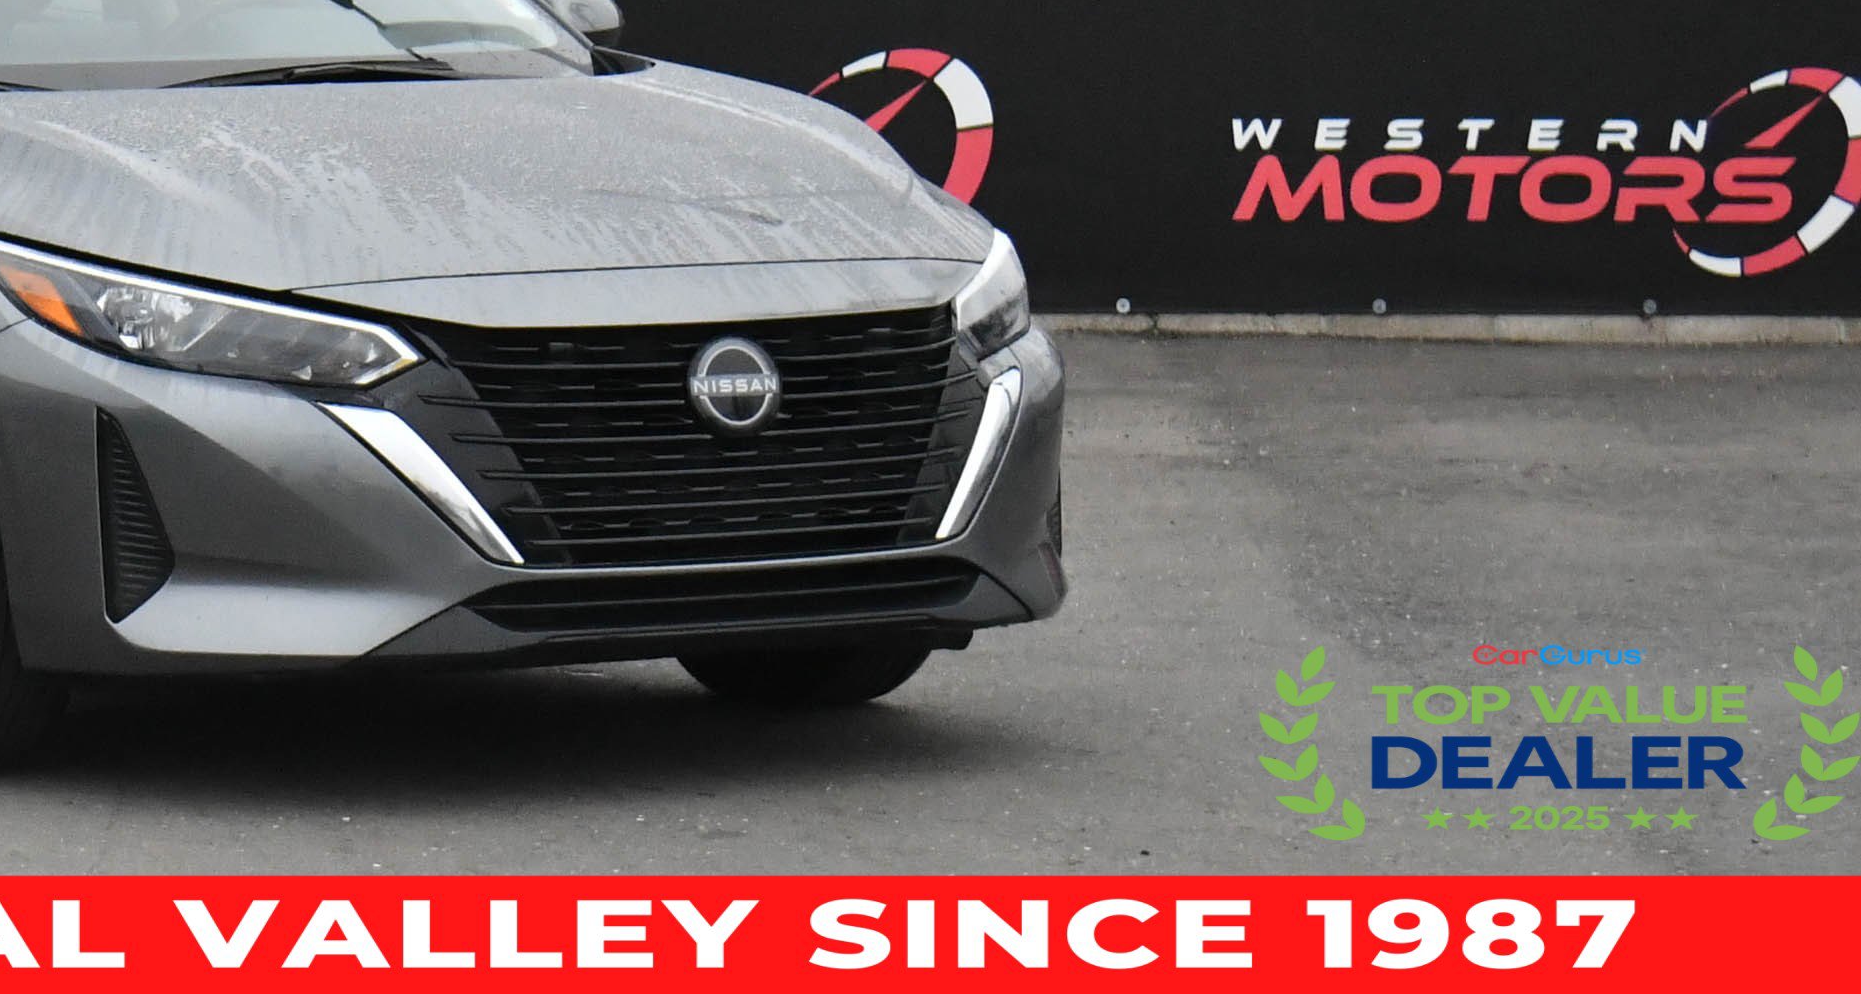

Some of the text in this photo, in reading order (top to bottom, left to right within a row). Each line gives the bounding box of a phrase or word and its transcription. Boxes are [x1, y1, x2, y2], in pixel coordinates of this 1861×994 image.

[1232, 118, 1708, 151] WESTERN
[1233, 154, 1796, 223] MOTORS
[693, 377, 777, 394] NISSAN
